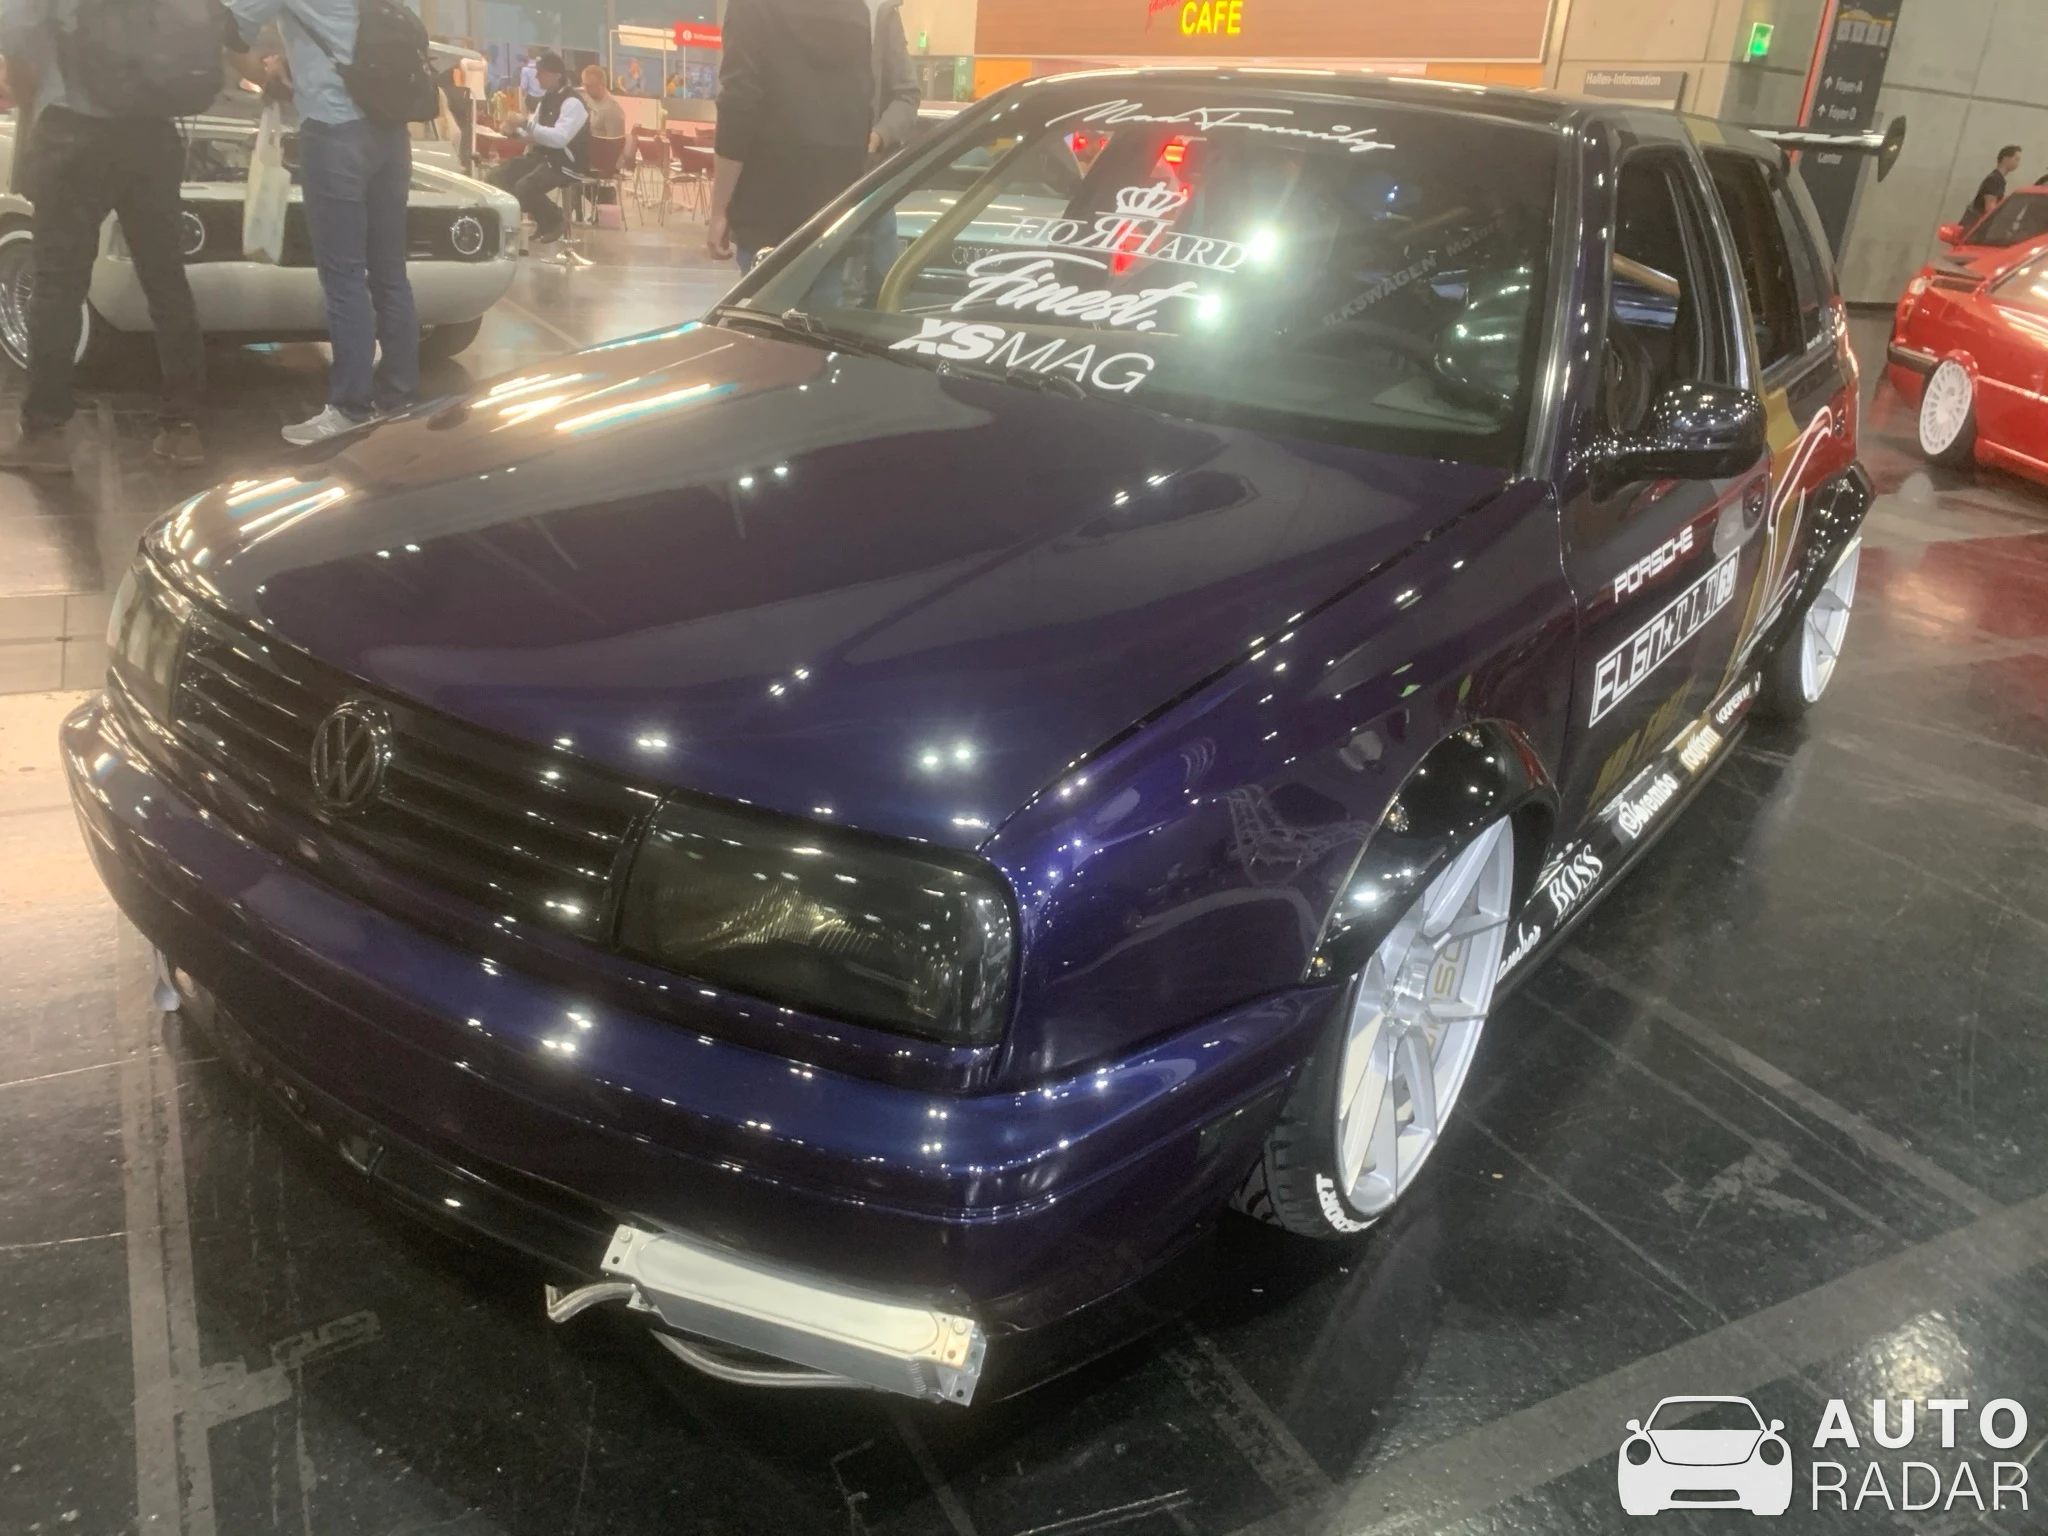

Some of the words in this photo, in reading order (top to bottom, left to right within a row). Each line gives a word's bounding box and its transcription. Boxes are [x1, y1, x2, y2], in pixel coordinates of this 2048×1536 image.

[1181, 0, 1243, 34] CAFE
[1586, 72, 1661, 85] Hallen-Information
[1614, 525, 1694, 603] PORSCHE
[1549, 843, 1603, 918] BOSS
